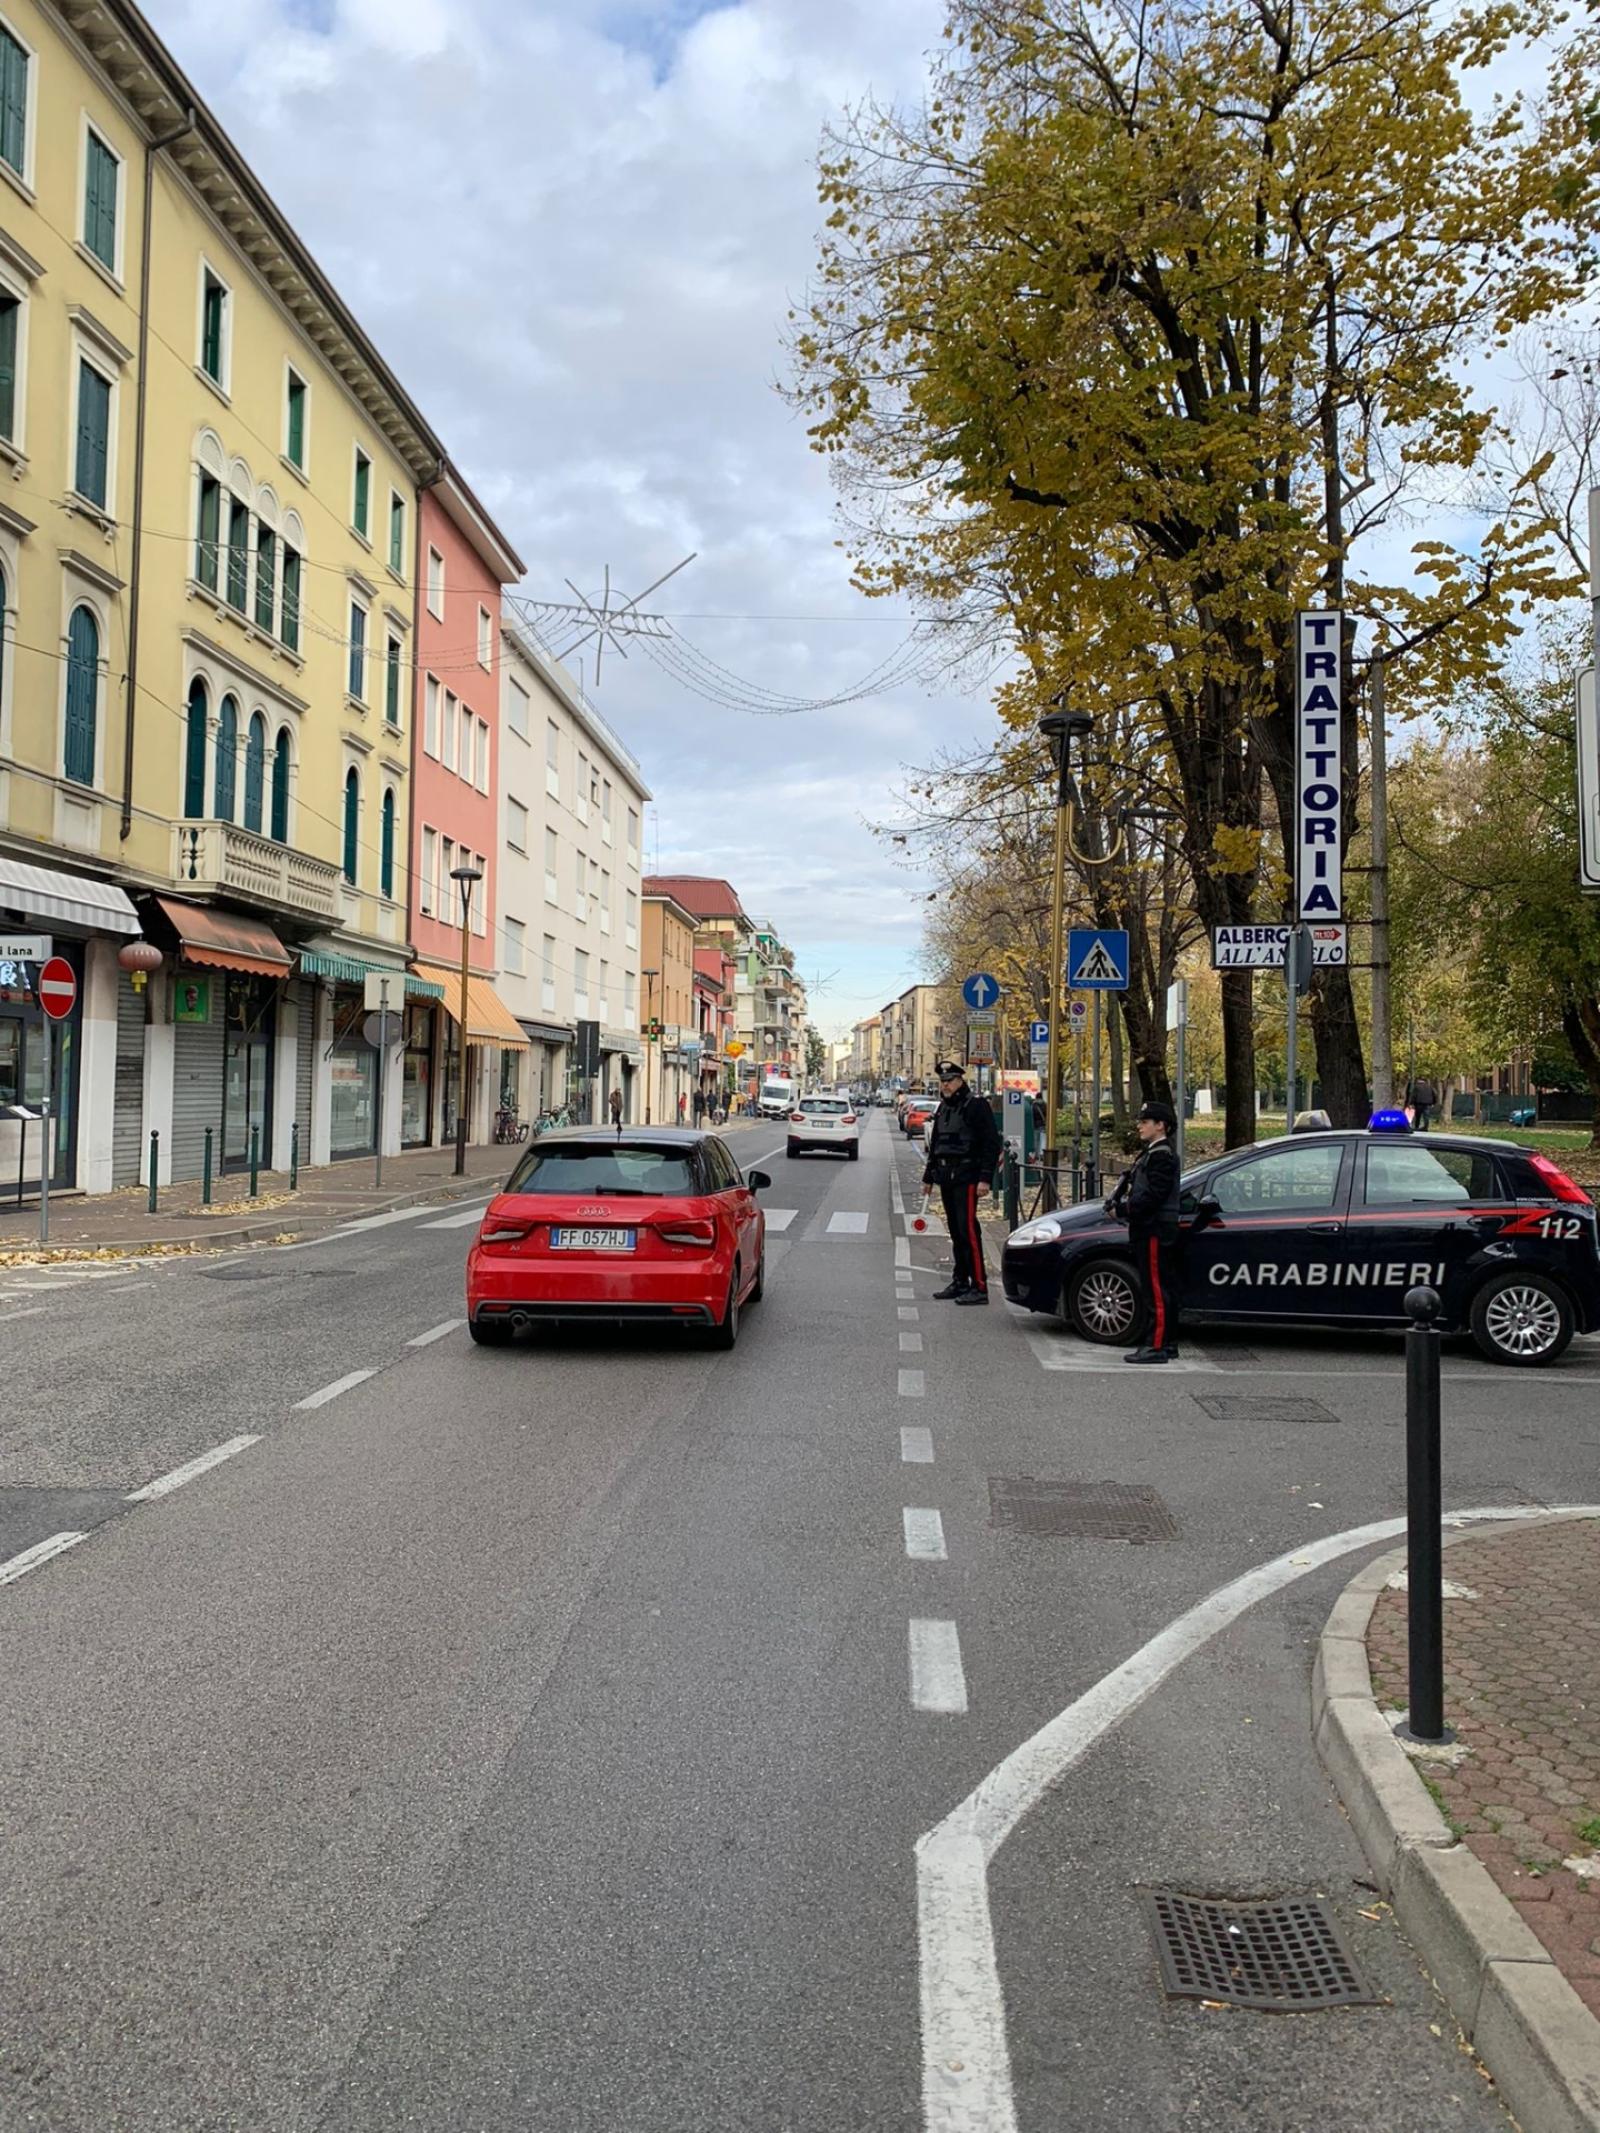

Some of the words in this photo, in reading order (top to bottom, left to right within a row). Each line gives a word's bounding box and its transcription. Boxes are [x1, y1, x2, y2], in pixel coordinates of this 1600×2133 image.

[1303, 618, 1339, 912] TRATTORIA
[1218, 927, 1290, 944] ALBERG
[7, 946, 33, 956] lana
[1035, 1023, 1049, 1041] P
[1010, 1091, 1020, 1104] P
[1539, 1217, 1581, 1239] 112
[560, 1230, 578, 1244] FF
[582, 1230, 627, 1245] 057HJ
[1209, 1262, 1445, 1286] CARABINIERI
